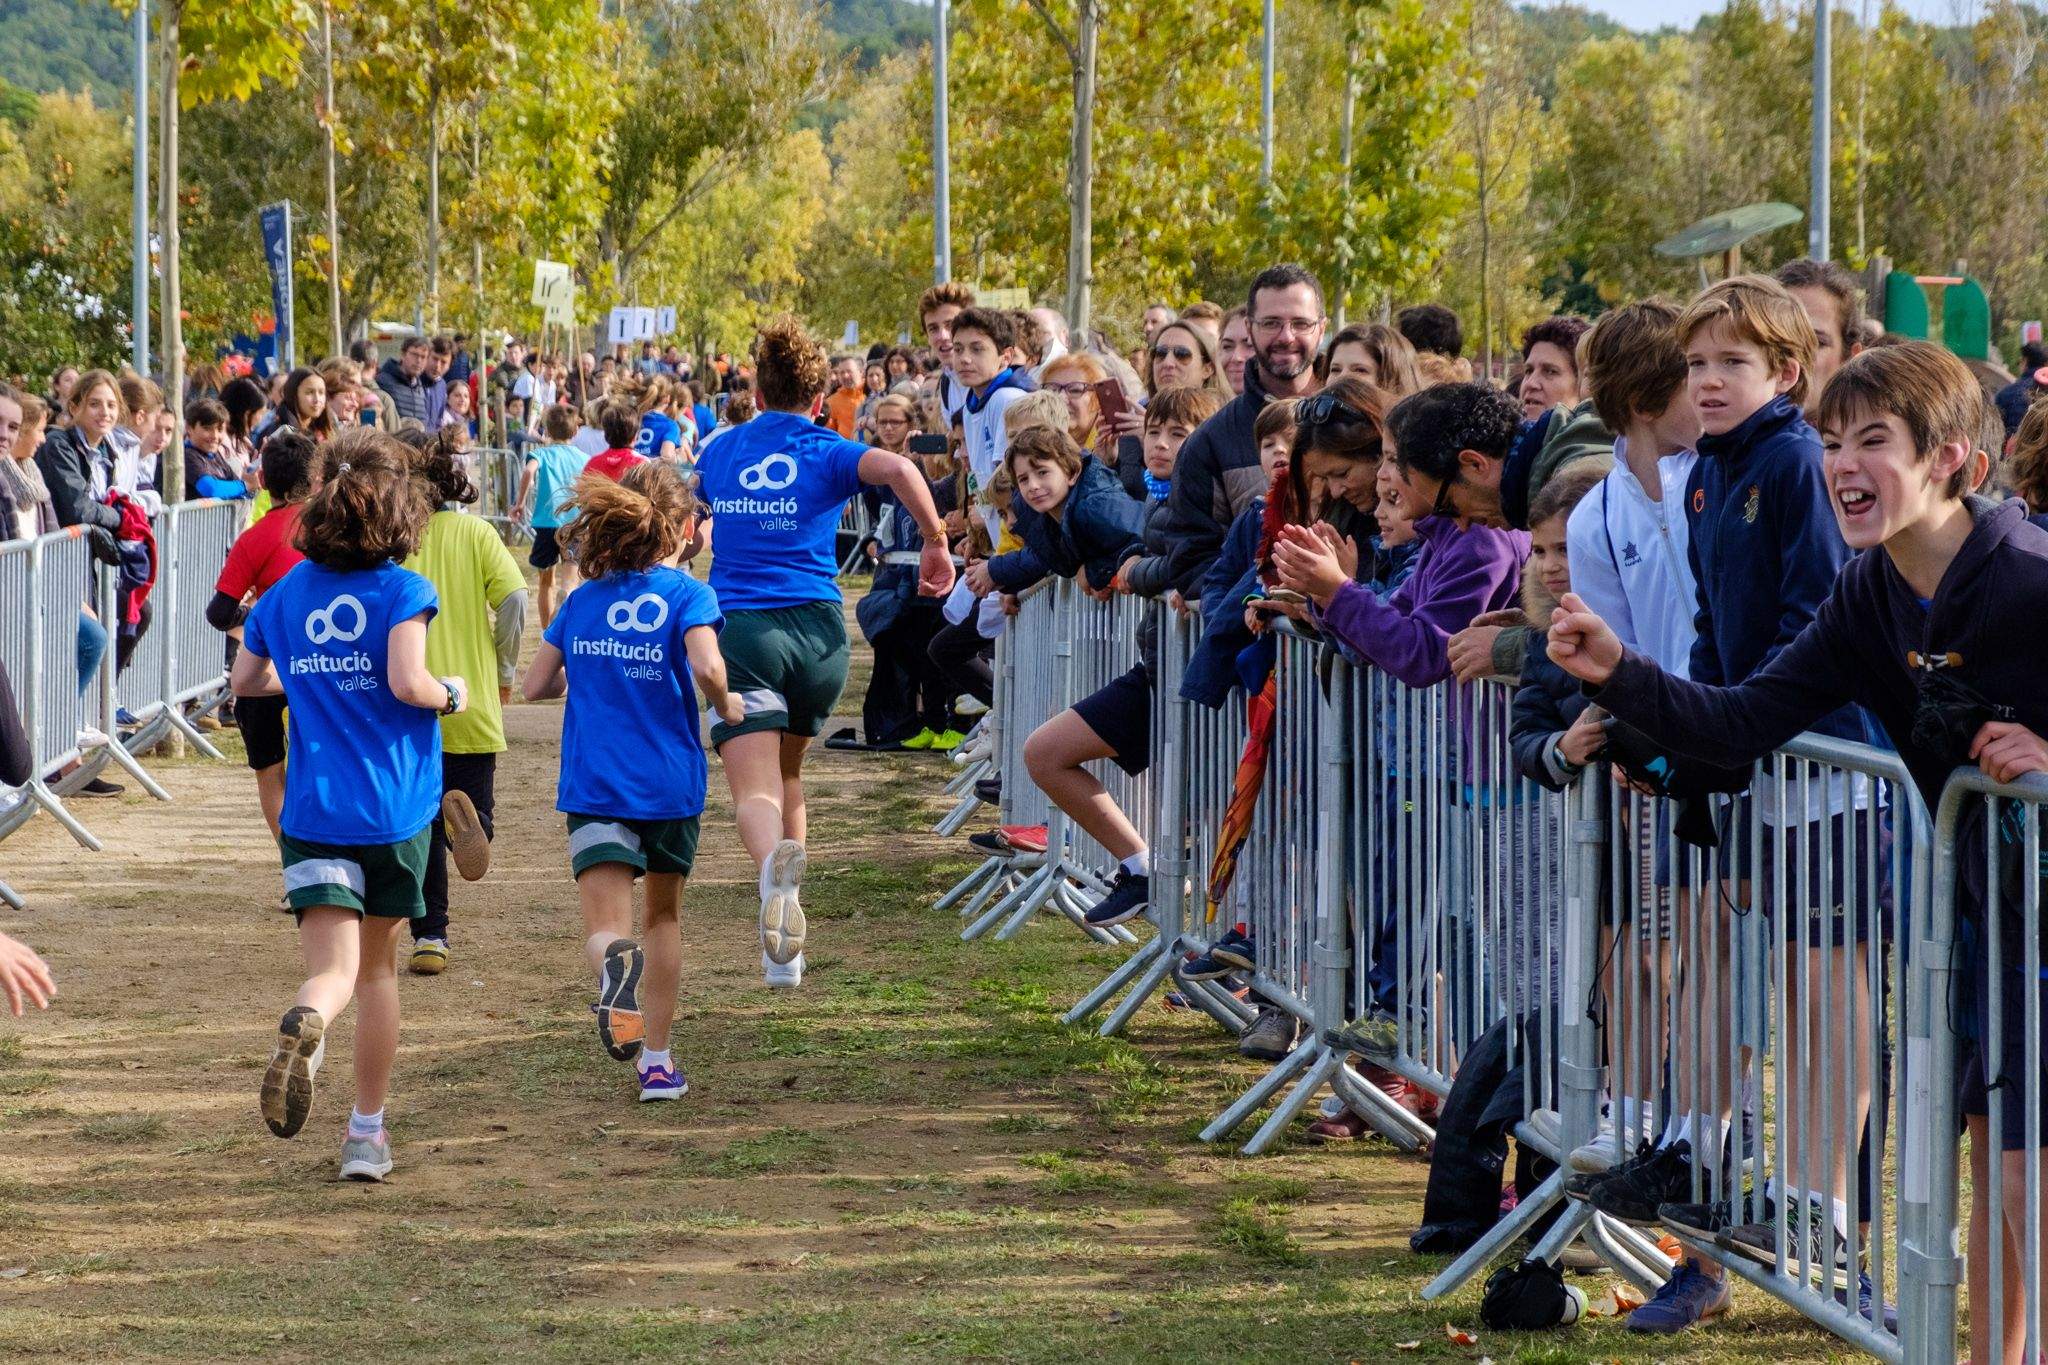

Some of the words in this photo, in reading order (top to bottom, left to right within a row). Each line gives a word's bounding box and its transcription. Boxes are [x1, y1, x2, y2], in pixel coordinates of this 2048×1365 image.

[712, 496, 798, 515] institució
[759, 517, 798, 531] vallès
[572, 636, 664, 663] institució
[622, 665, 663, 681] vallès
[335, 675, 378, 692] vallès
